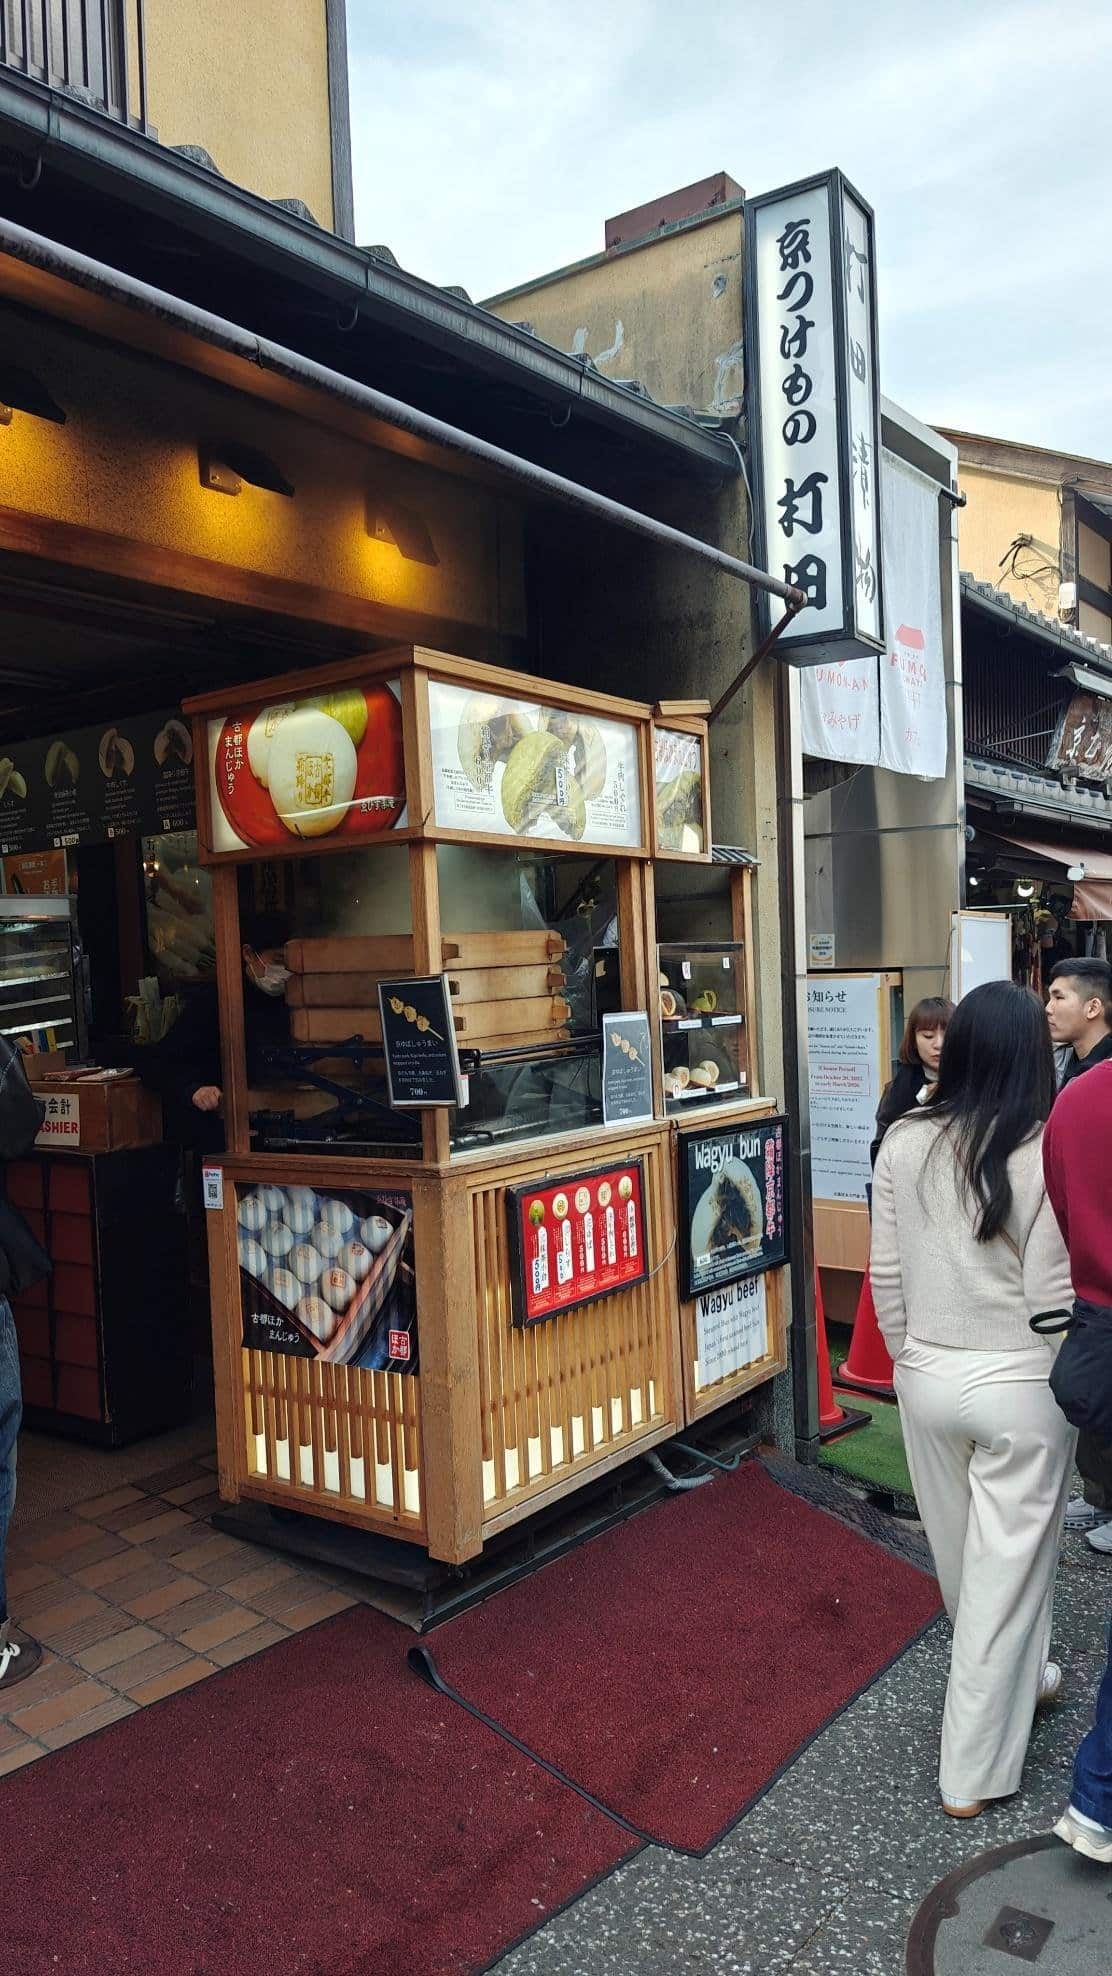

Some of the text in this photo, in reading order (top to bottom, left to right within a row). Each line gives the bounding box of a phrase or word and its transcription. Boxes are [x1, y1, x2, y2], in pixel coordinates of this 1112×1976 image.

[775, 218, 829, 613] 京つけもの 打田
[224, 735, 236, 795] まんじゅう
[48, 1097, 72, 1115] 会計
[695, 1134, 761, 1174] Wagyu bun
[700, 1277, 759, 1318] Wagyu beef
[250, 1312, 284, 1327] 古都ほか
[268, 1329, 300, 1343] まんじゅう
